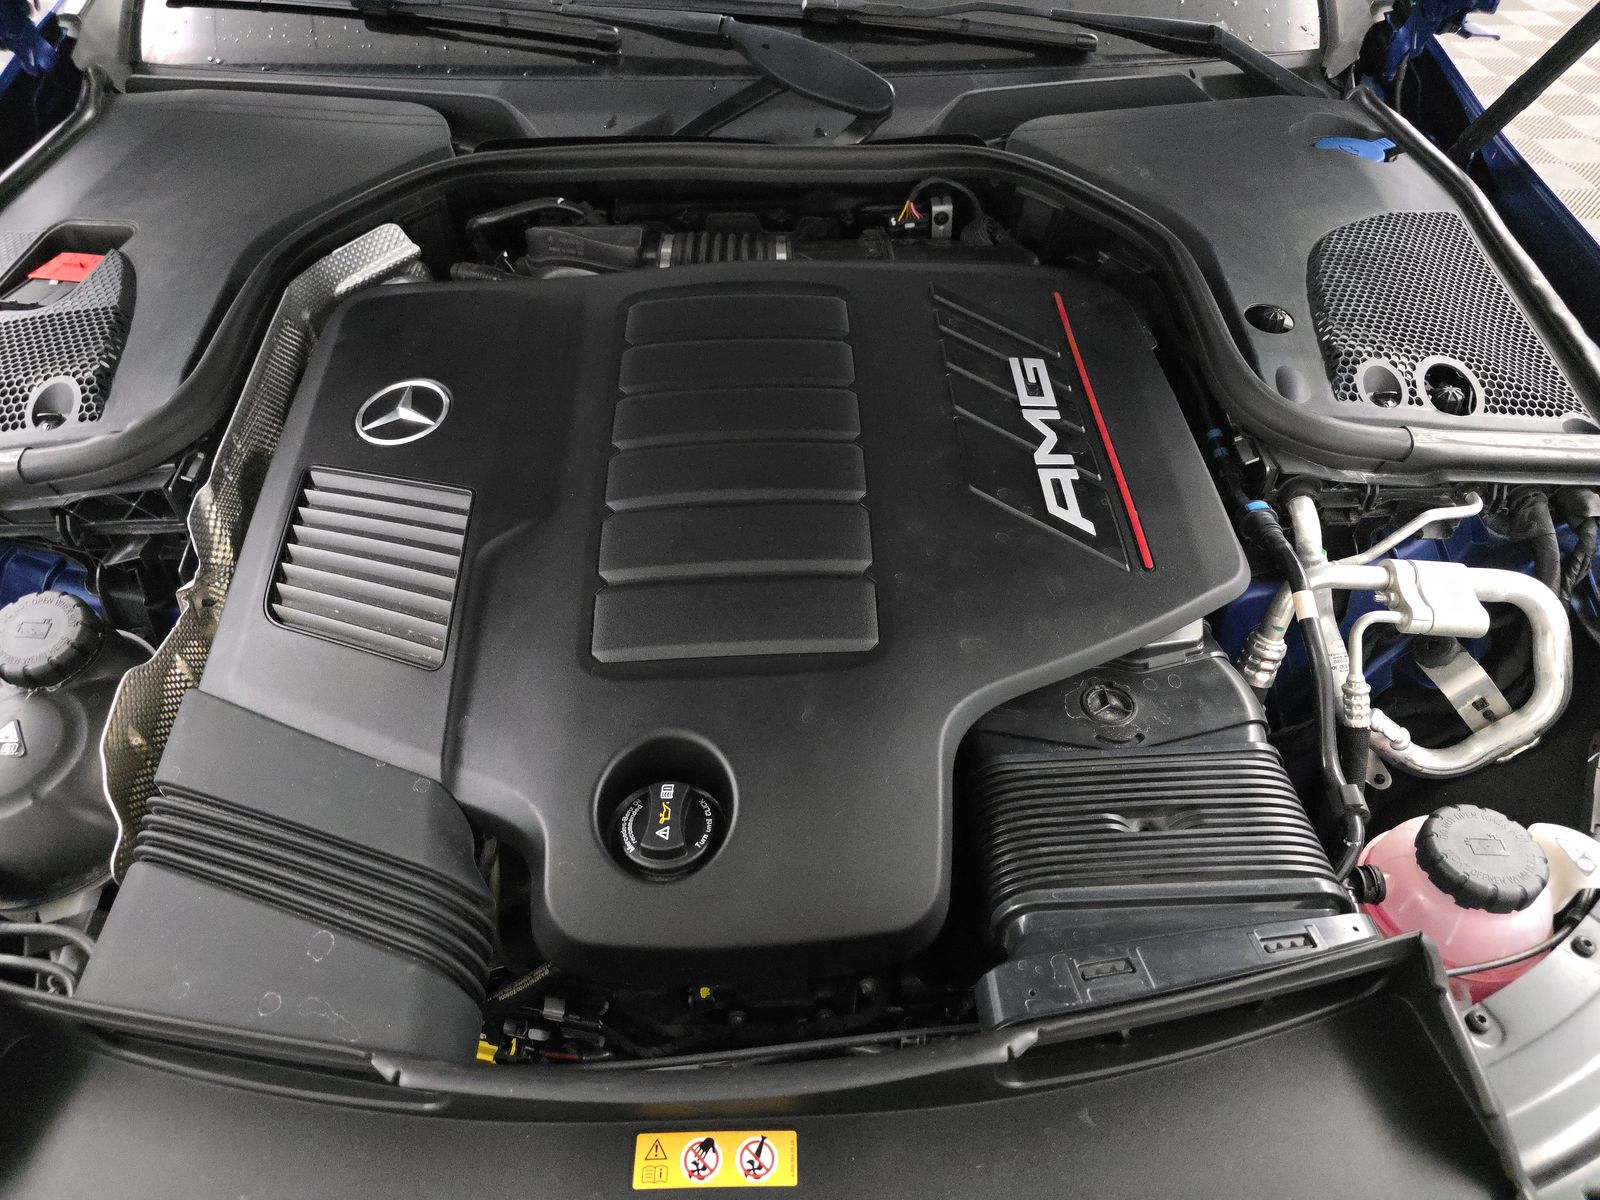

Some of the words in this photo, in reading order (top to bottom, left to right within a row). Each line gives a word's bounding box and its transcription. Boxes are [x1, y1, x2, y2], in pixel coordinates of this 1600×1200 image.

[1008, 357, 1097, 536] AMG
[620, 806, 636, 853] Mercedes-Benz
[694, 834, 709, 849] Turn
[705, 818, 713, 833] until
